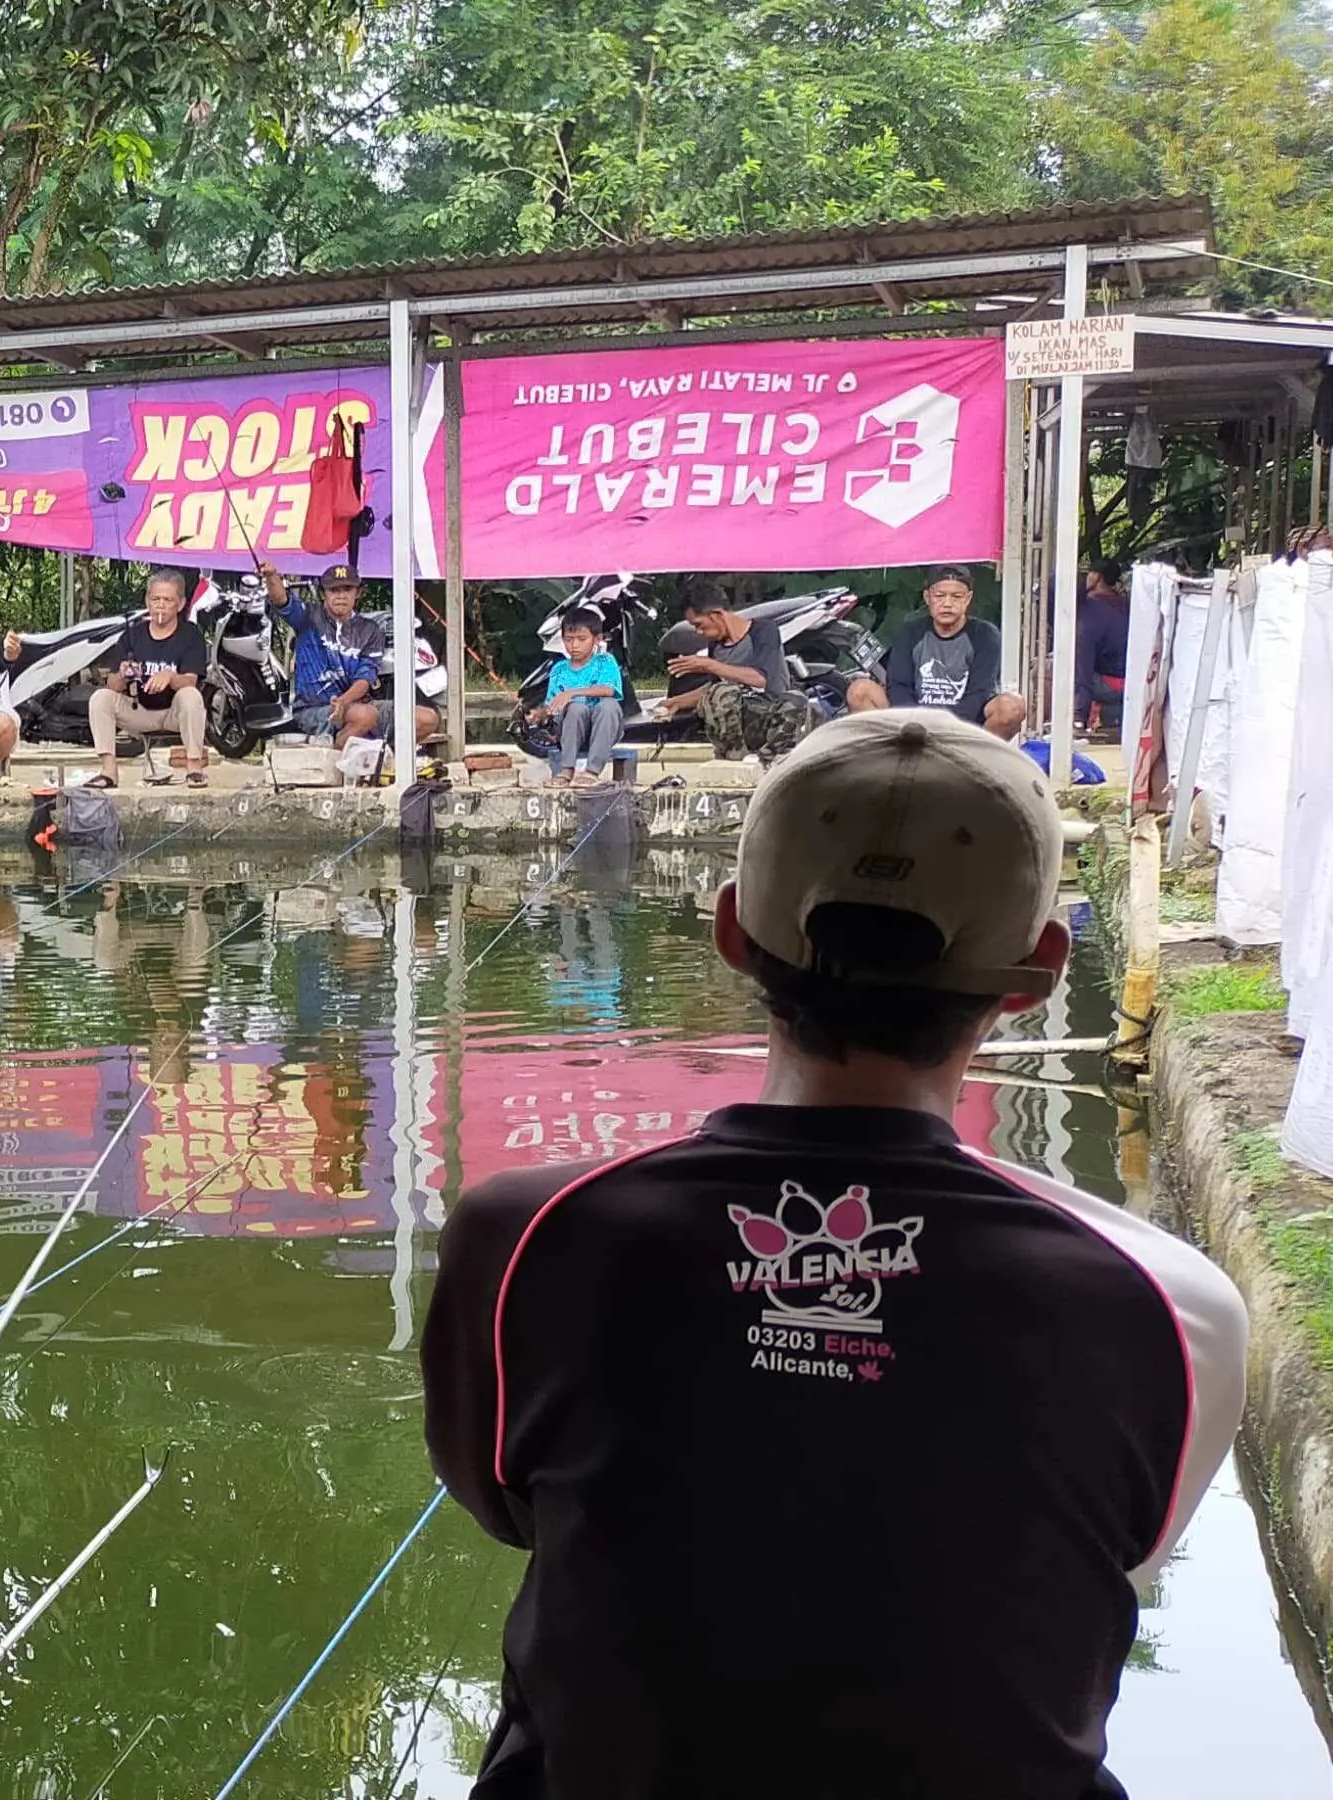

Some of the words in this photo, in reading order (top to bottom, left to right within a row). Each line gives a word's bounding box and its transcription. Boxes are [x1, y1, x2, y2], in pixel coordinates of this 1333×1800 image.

[1013, 322, 1062, 339] KOLAM
[1069, 317, 1124, 334] HARIAN
[1038, 338, 1071, 351] IKAN
[1078, 335, 1108, 349] MAS
[1023, 349, 1089, 364] SETENGAH
[1095, 347, 1123, 359] HARI
[700, 369, 793, 393] MELATI
[1016, 365, 1027, 376] DI
[513, 382, 613, 406] CILEBUT
[618, 372, 694, 399] RAYA,
[801, 373, 830, 393] JL
[536, 411, 821, 466] CILEBUT
[505, 460, 827, 516] EMERALD
[133, 482, 363, 550] EADY
[320, 800, 334, 820] 8
[526, 796, 540, 818] 6
[695, 795, 711, 817] 4
[726, 1244, 921, 1292] VALENCIA
[819, 1283, 868, 1312] Sol.
[746, 1324, 817, 1351] 03203
[824, 1334, 896, 1360] Elche,
[750, 1349, 855, 1382] Alicante,
